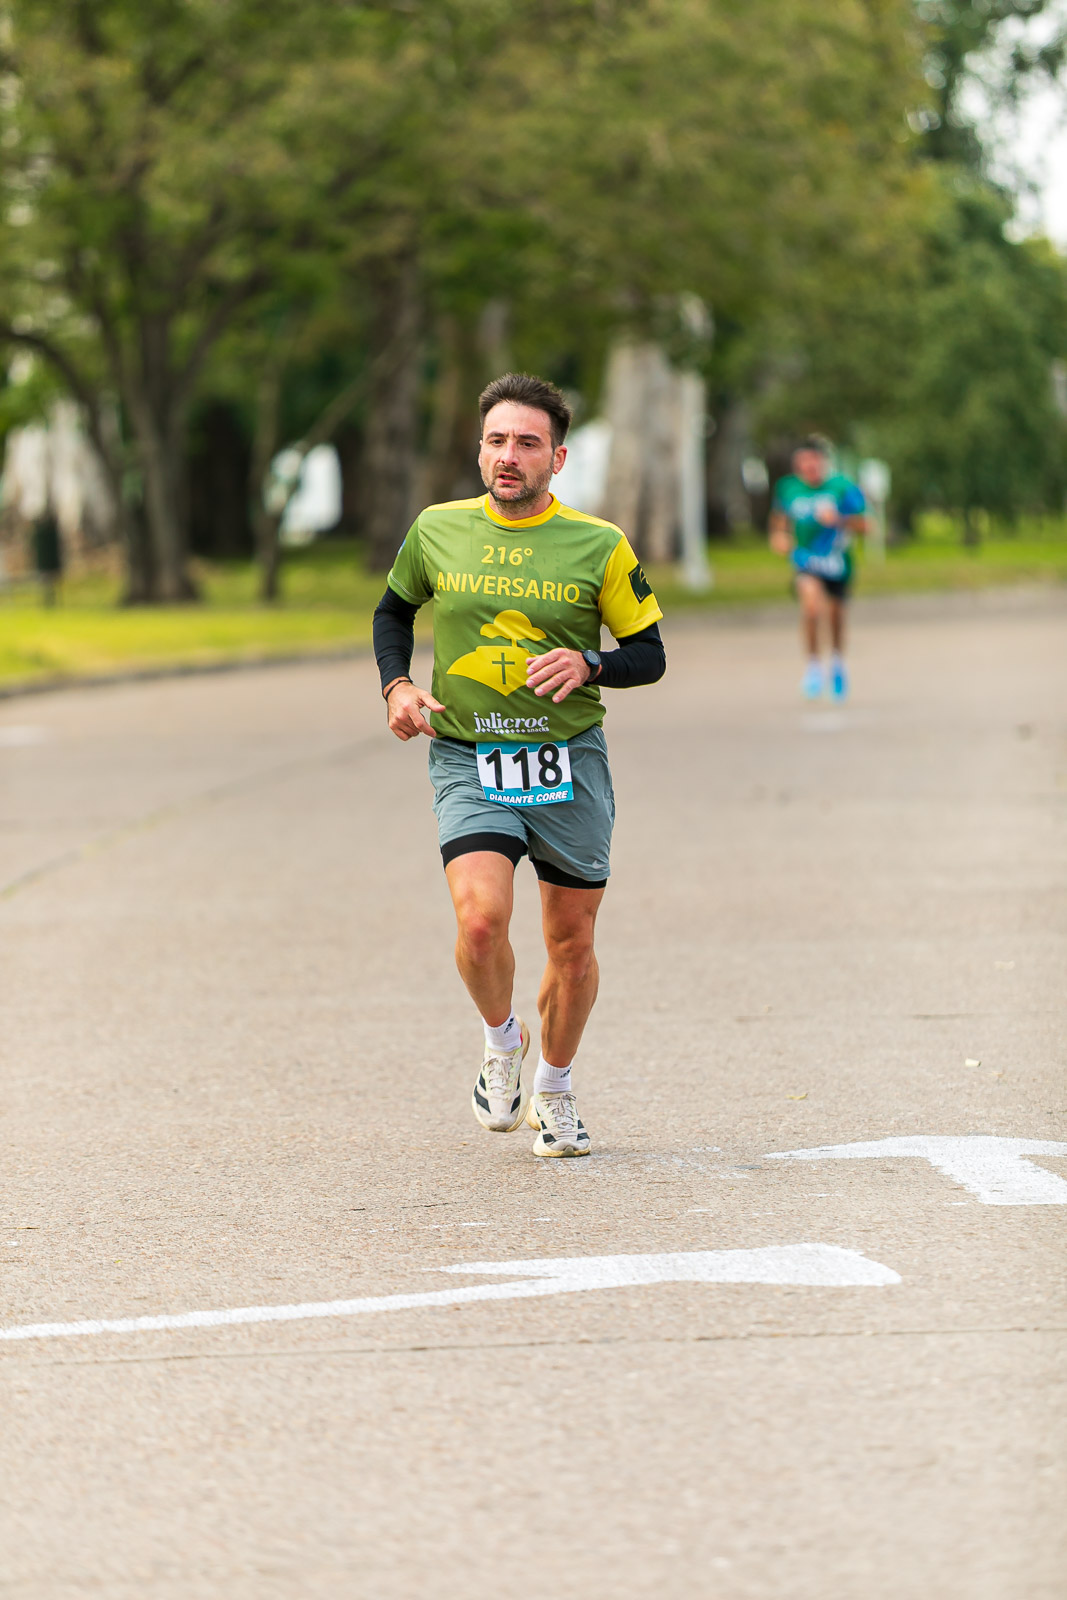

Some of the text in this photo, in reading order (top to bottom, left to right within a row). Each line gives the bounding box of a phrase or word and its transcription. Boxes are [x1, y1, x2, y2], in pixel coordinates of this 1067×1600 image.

[481, 545, 533, 566] 216°
[437, 572, 580, 603] ANIVERSARIO
[473, 711, 549, 733] julicroc
[485, 742, 563, 792] 118
[489, 790, 568, 804] DIAMANTE CORRE
